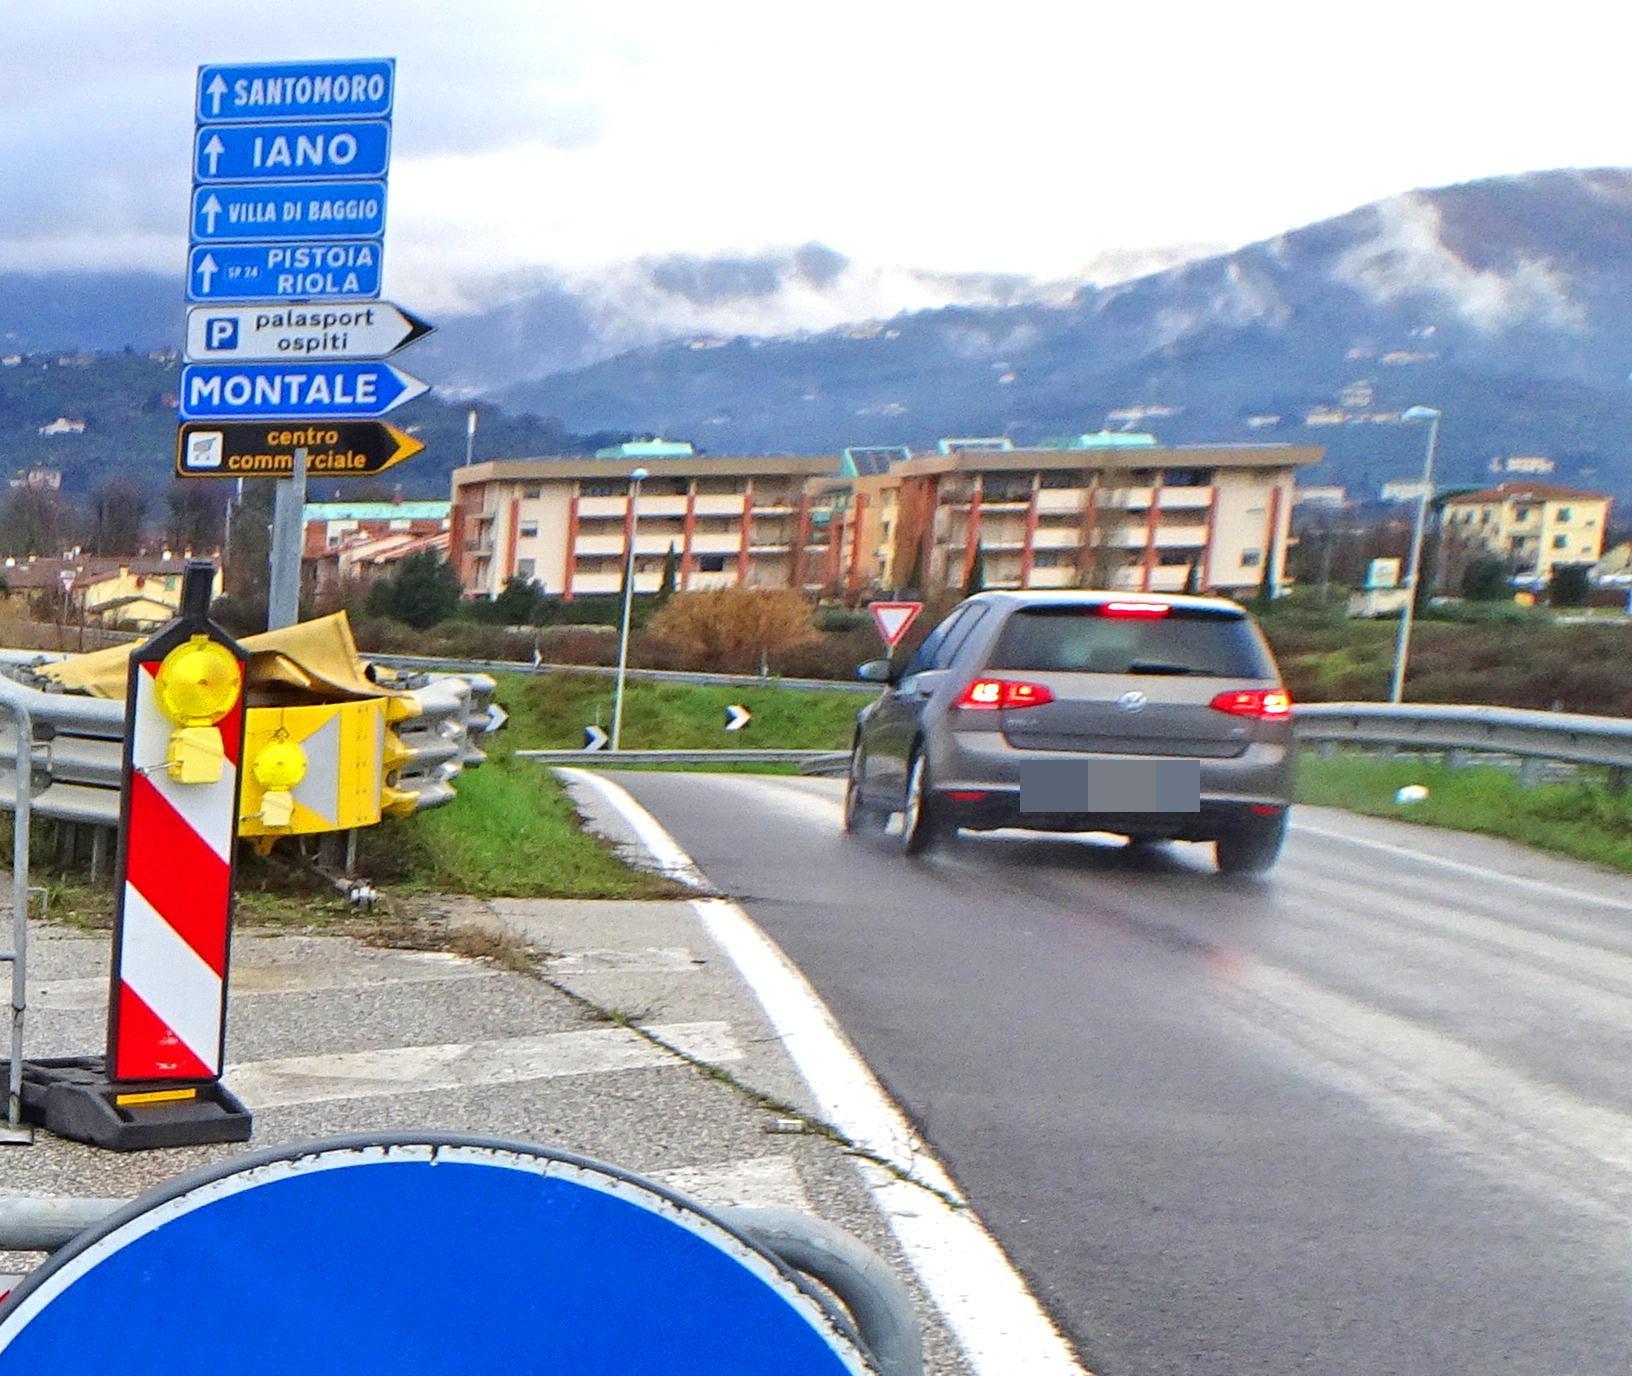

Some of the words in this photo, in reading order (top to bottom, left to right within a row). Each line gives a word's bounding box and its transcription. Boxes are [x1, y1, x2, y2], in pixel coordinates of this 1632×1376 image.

[234, 74, 385, 106] SANTOMORO
[253, 133, 358, 167] IANO
[229, 202, 276, 223] VILLA
[282, 201, 302, 221] DI
[308, 199, 378, 221] BAGGIO
[267, 247, 373, 269] PISTOIA
[277, 271, 360, 294] RIOLA
[255, 309, 374, 331] palasport
[211, 320, 234, 347] P
[277, 333, 348, 353] ospiti
[190, 373, 378, 405] MONTALE
[267, 428, 338, 446] centro
[228, 449, 367, 469] commrciale
